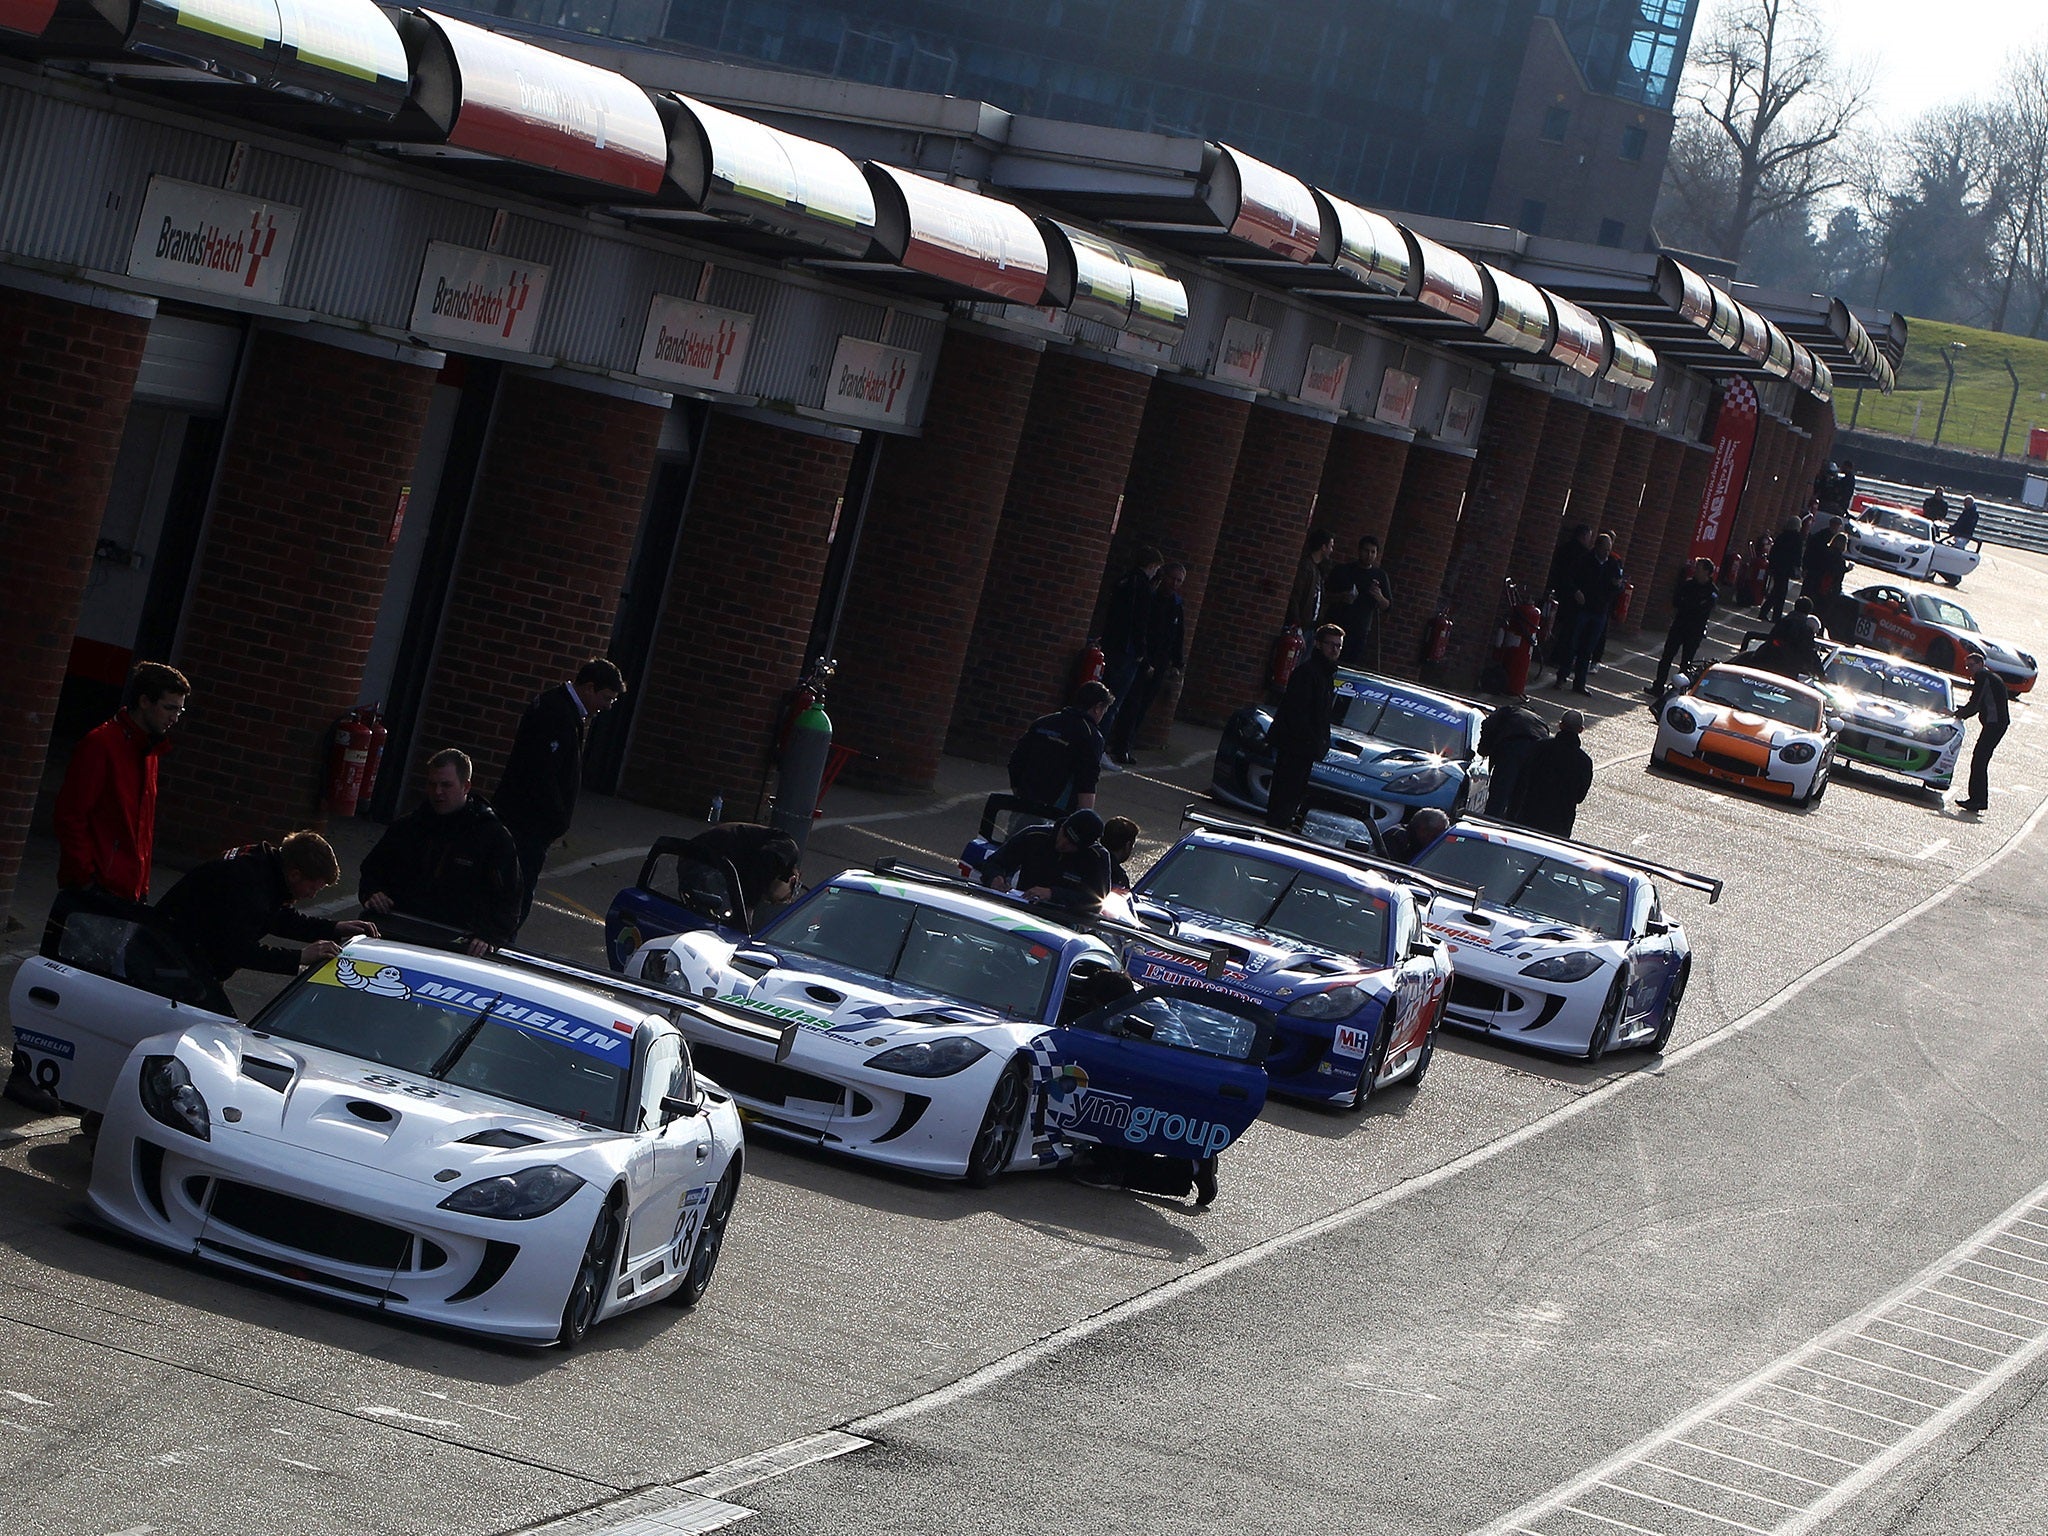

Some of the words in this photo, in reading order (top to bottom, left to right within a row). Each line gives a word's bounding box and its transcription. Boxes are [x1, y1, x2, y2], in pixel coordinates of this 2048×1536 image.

[155, 215, 244, 274] BrandsHatch
[431, 276, 503, 326] BrandsHatch
[654, 325, 714, 369] BrandsHatch
[838, 364, 888, 404] BrandsHatch
[1856, 619, 1871, 637] 68
[1879, 618, 1916, 641] QUATTRO
[1871, 661, 1944, 689] MICHELIN
[1361, 689, 1462, 725] MICHELIN
[44, 961, 68, 974] WALL
[416, 981, 622, 1051] MICHELIN
[20, 1033, 72, 1054] MICHELIN
[1340, 1028, 1367, 1050] MH
[363, 1074, 440, 1099] 88
[1062, 1093, 1231, 1159] ymgroup
[672, 1208, 698, 1270] 88
